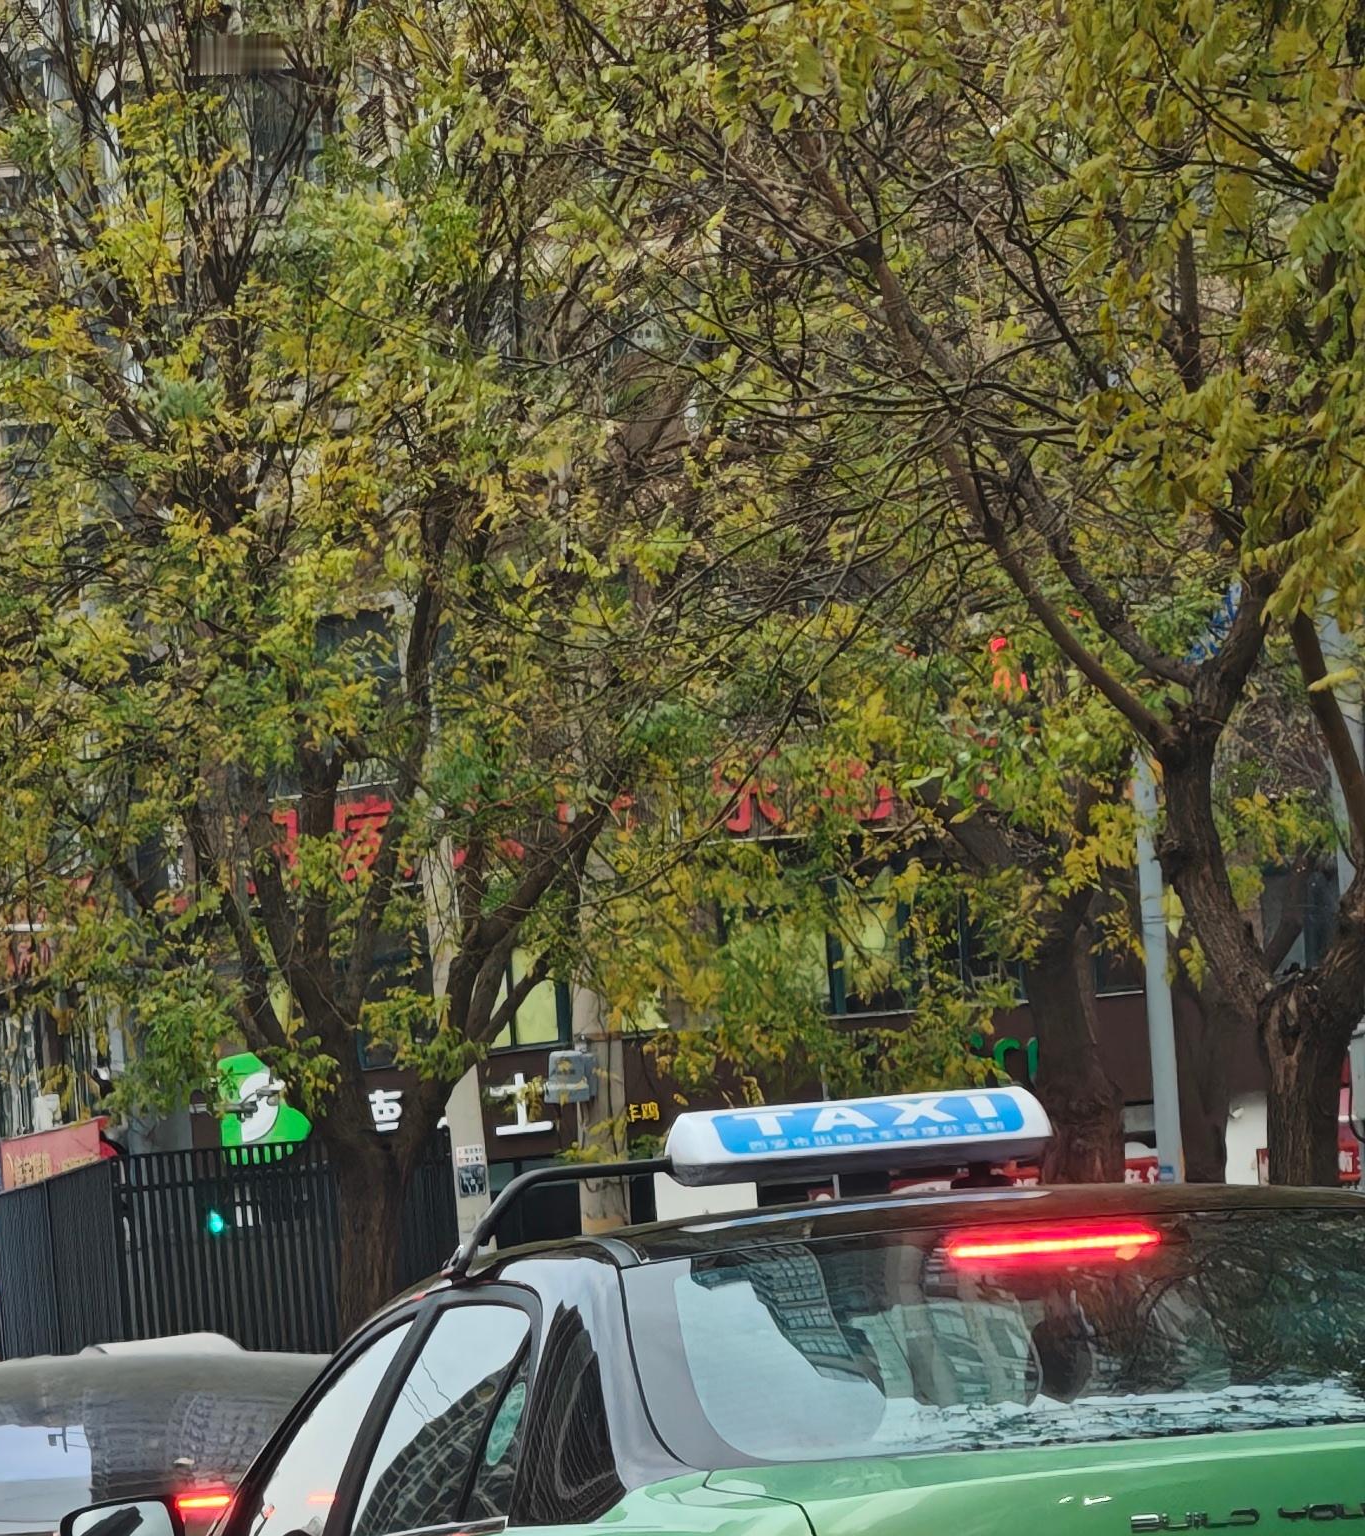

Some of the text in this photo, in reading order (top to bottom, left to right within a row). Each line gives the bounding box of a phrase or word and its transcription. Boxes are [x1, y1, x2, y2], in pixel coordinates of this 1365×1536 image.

[732, 1095, 998, 1137] TAXI
[1130, 1503, 1365, 1533] BUILD YOU
